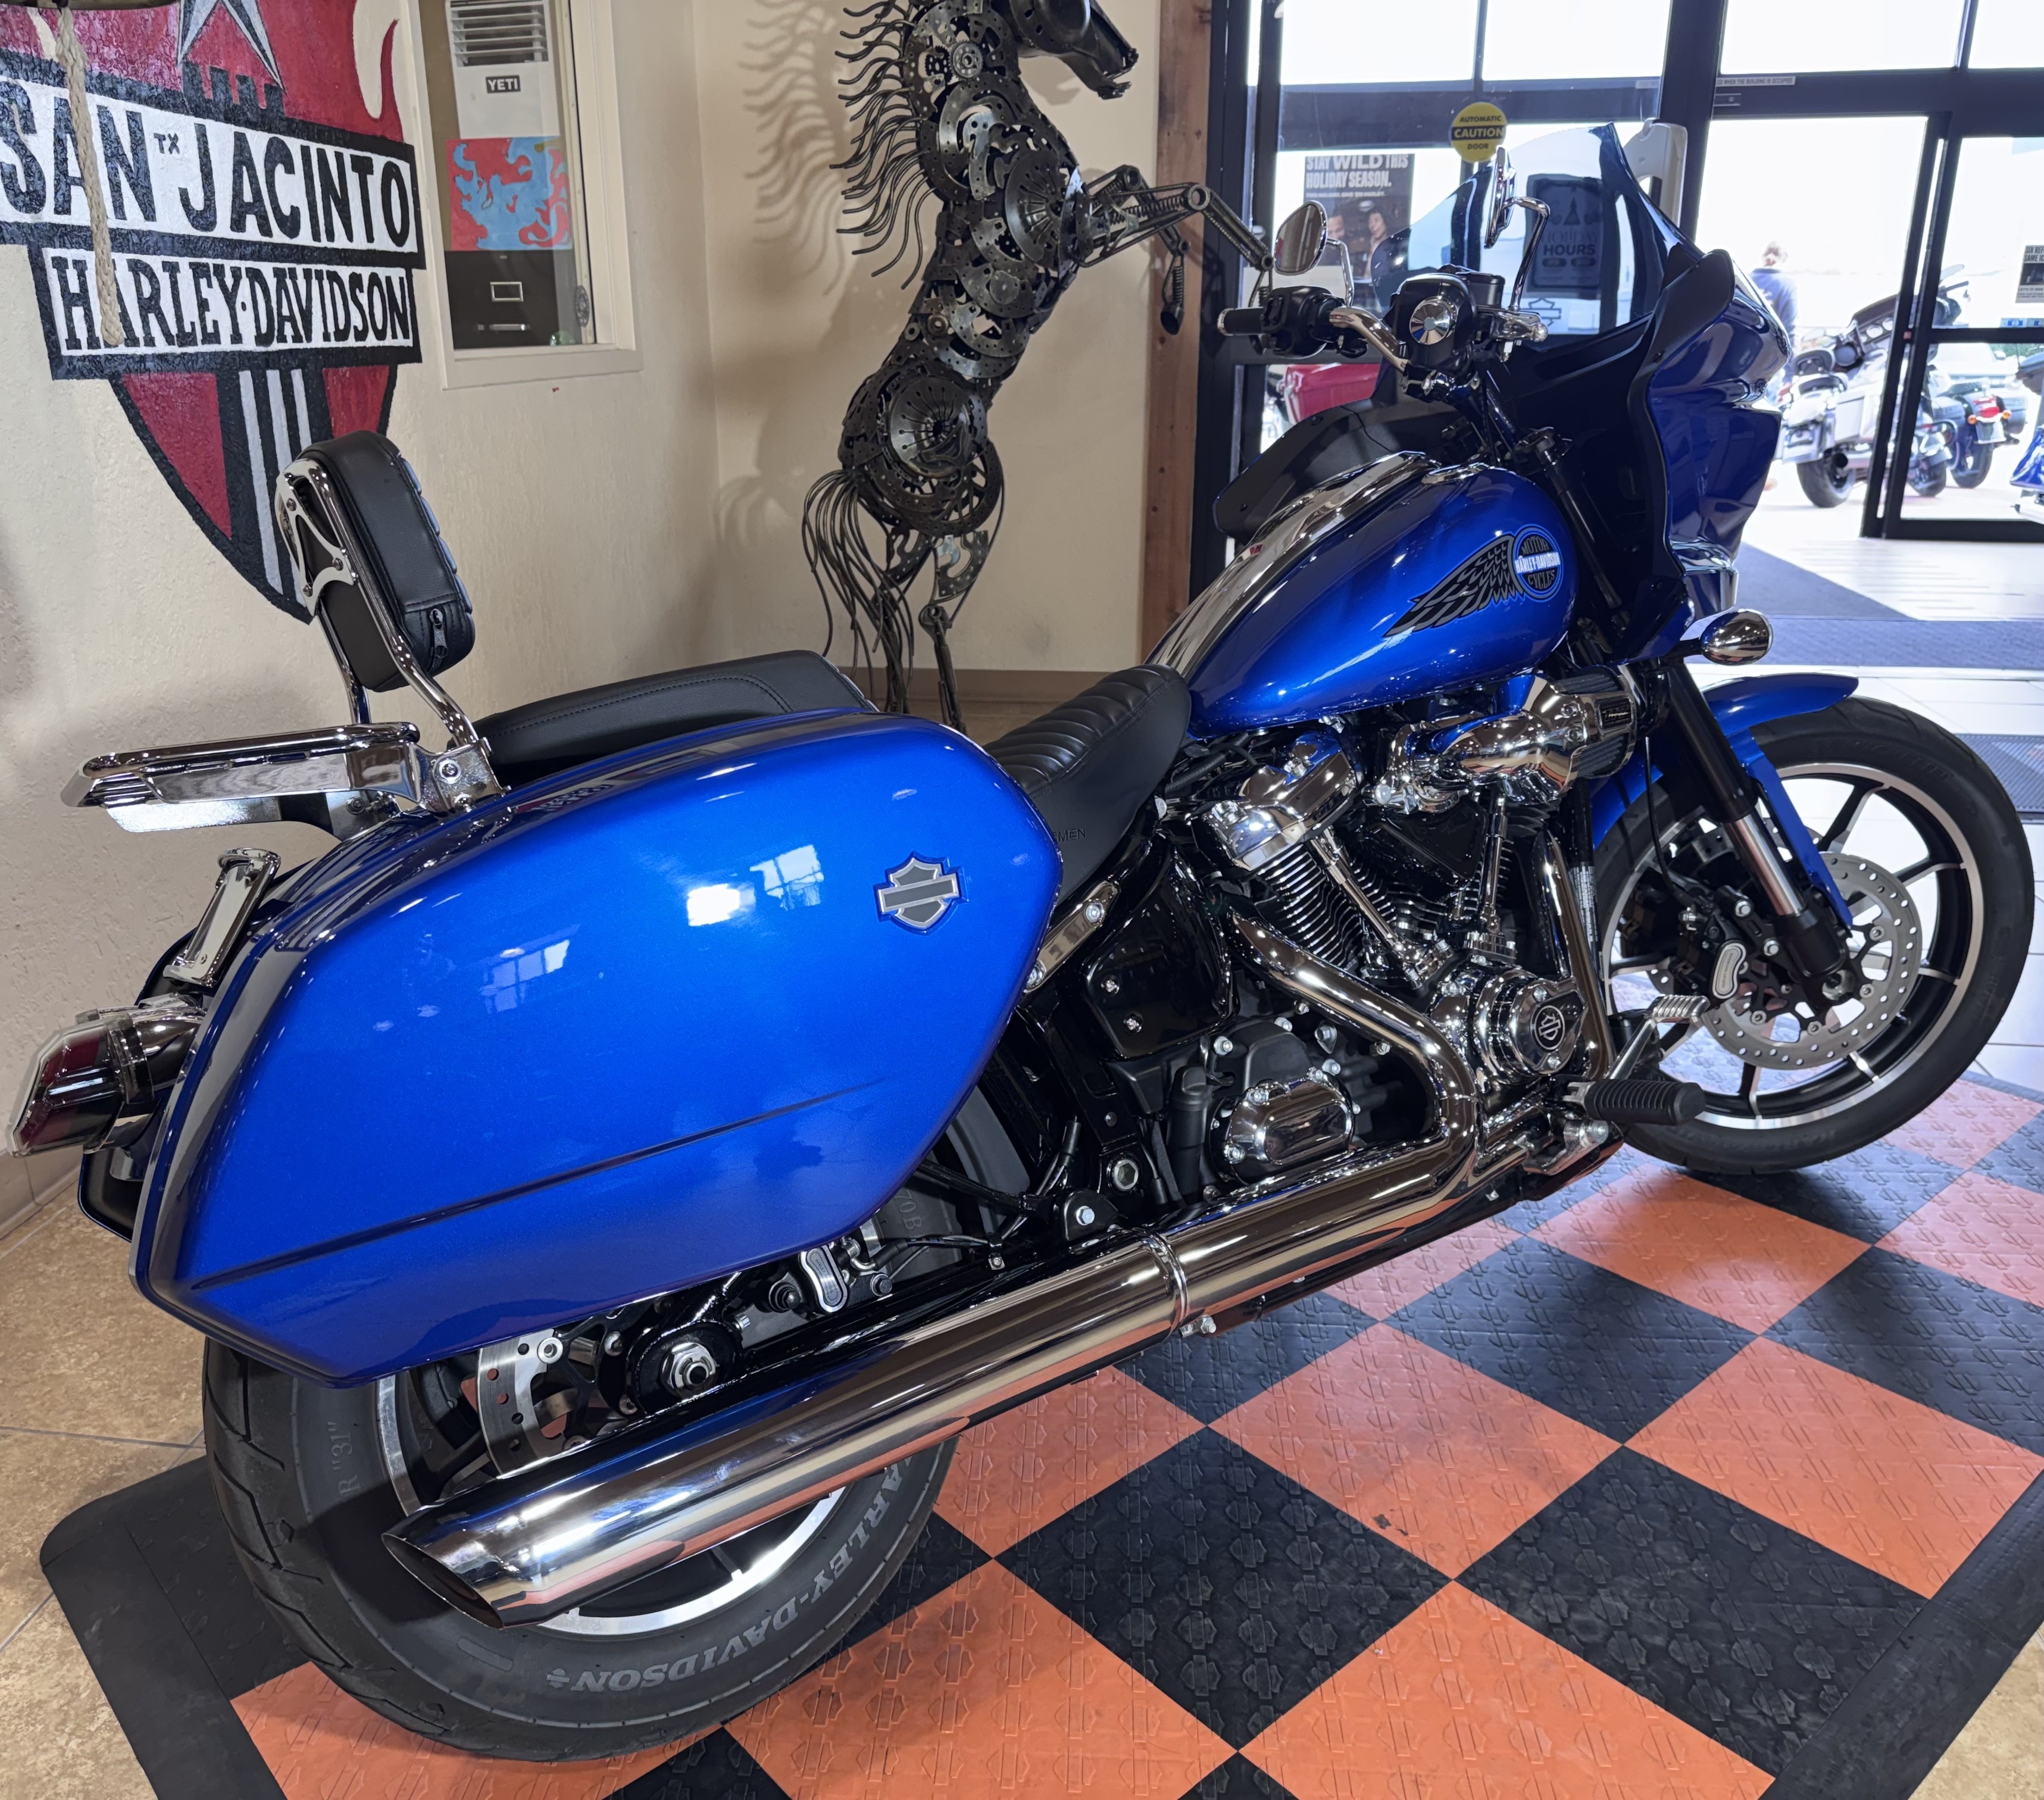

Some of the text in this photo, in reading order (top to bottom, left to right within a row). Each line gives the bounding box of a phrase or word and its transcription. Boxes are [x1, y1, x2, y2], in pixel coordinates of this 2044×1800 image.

[487, 78, 518, 91] YETI
[1454, 127, 1504, 138] CAUTION
[0, 81, 157, 222] SAN
[178, 123, 410, 248] JACINTO
[1307, 154, 1409, 170] STAY WILD THIS
[1306, 170, 1392, 189] HOLIDAY SEASON.
[1543, 243, 1596, 256] HOURS
[1521, 536, 1550, 555] MOTOR
[1515, 552, 1561, 574] HARLEY-DAVIDSON
[1527, 570, 1555, 589] CYCLES
[570, 1457, 912, 1692] ARLEY-DAVIDSON
